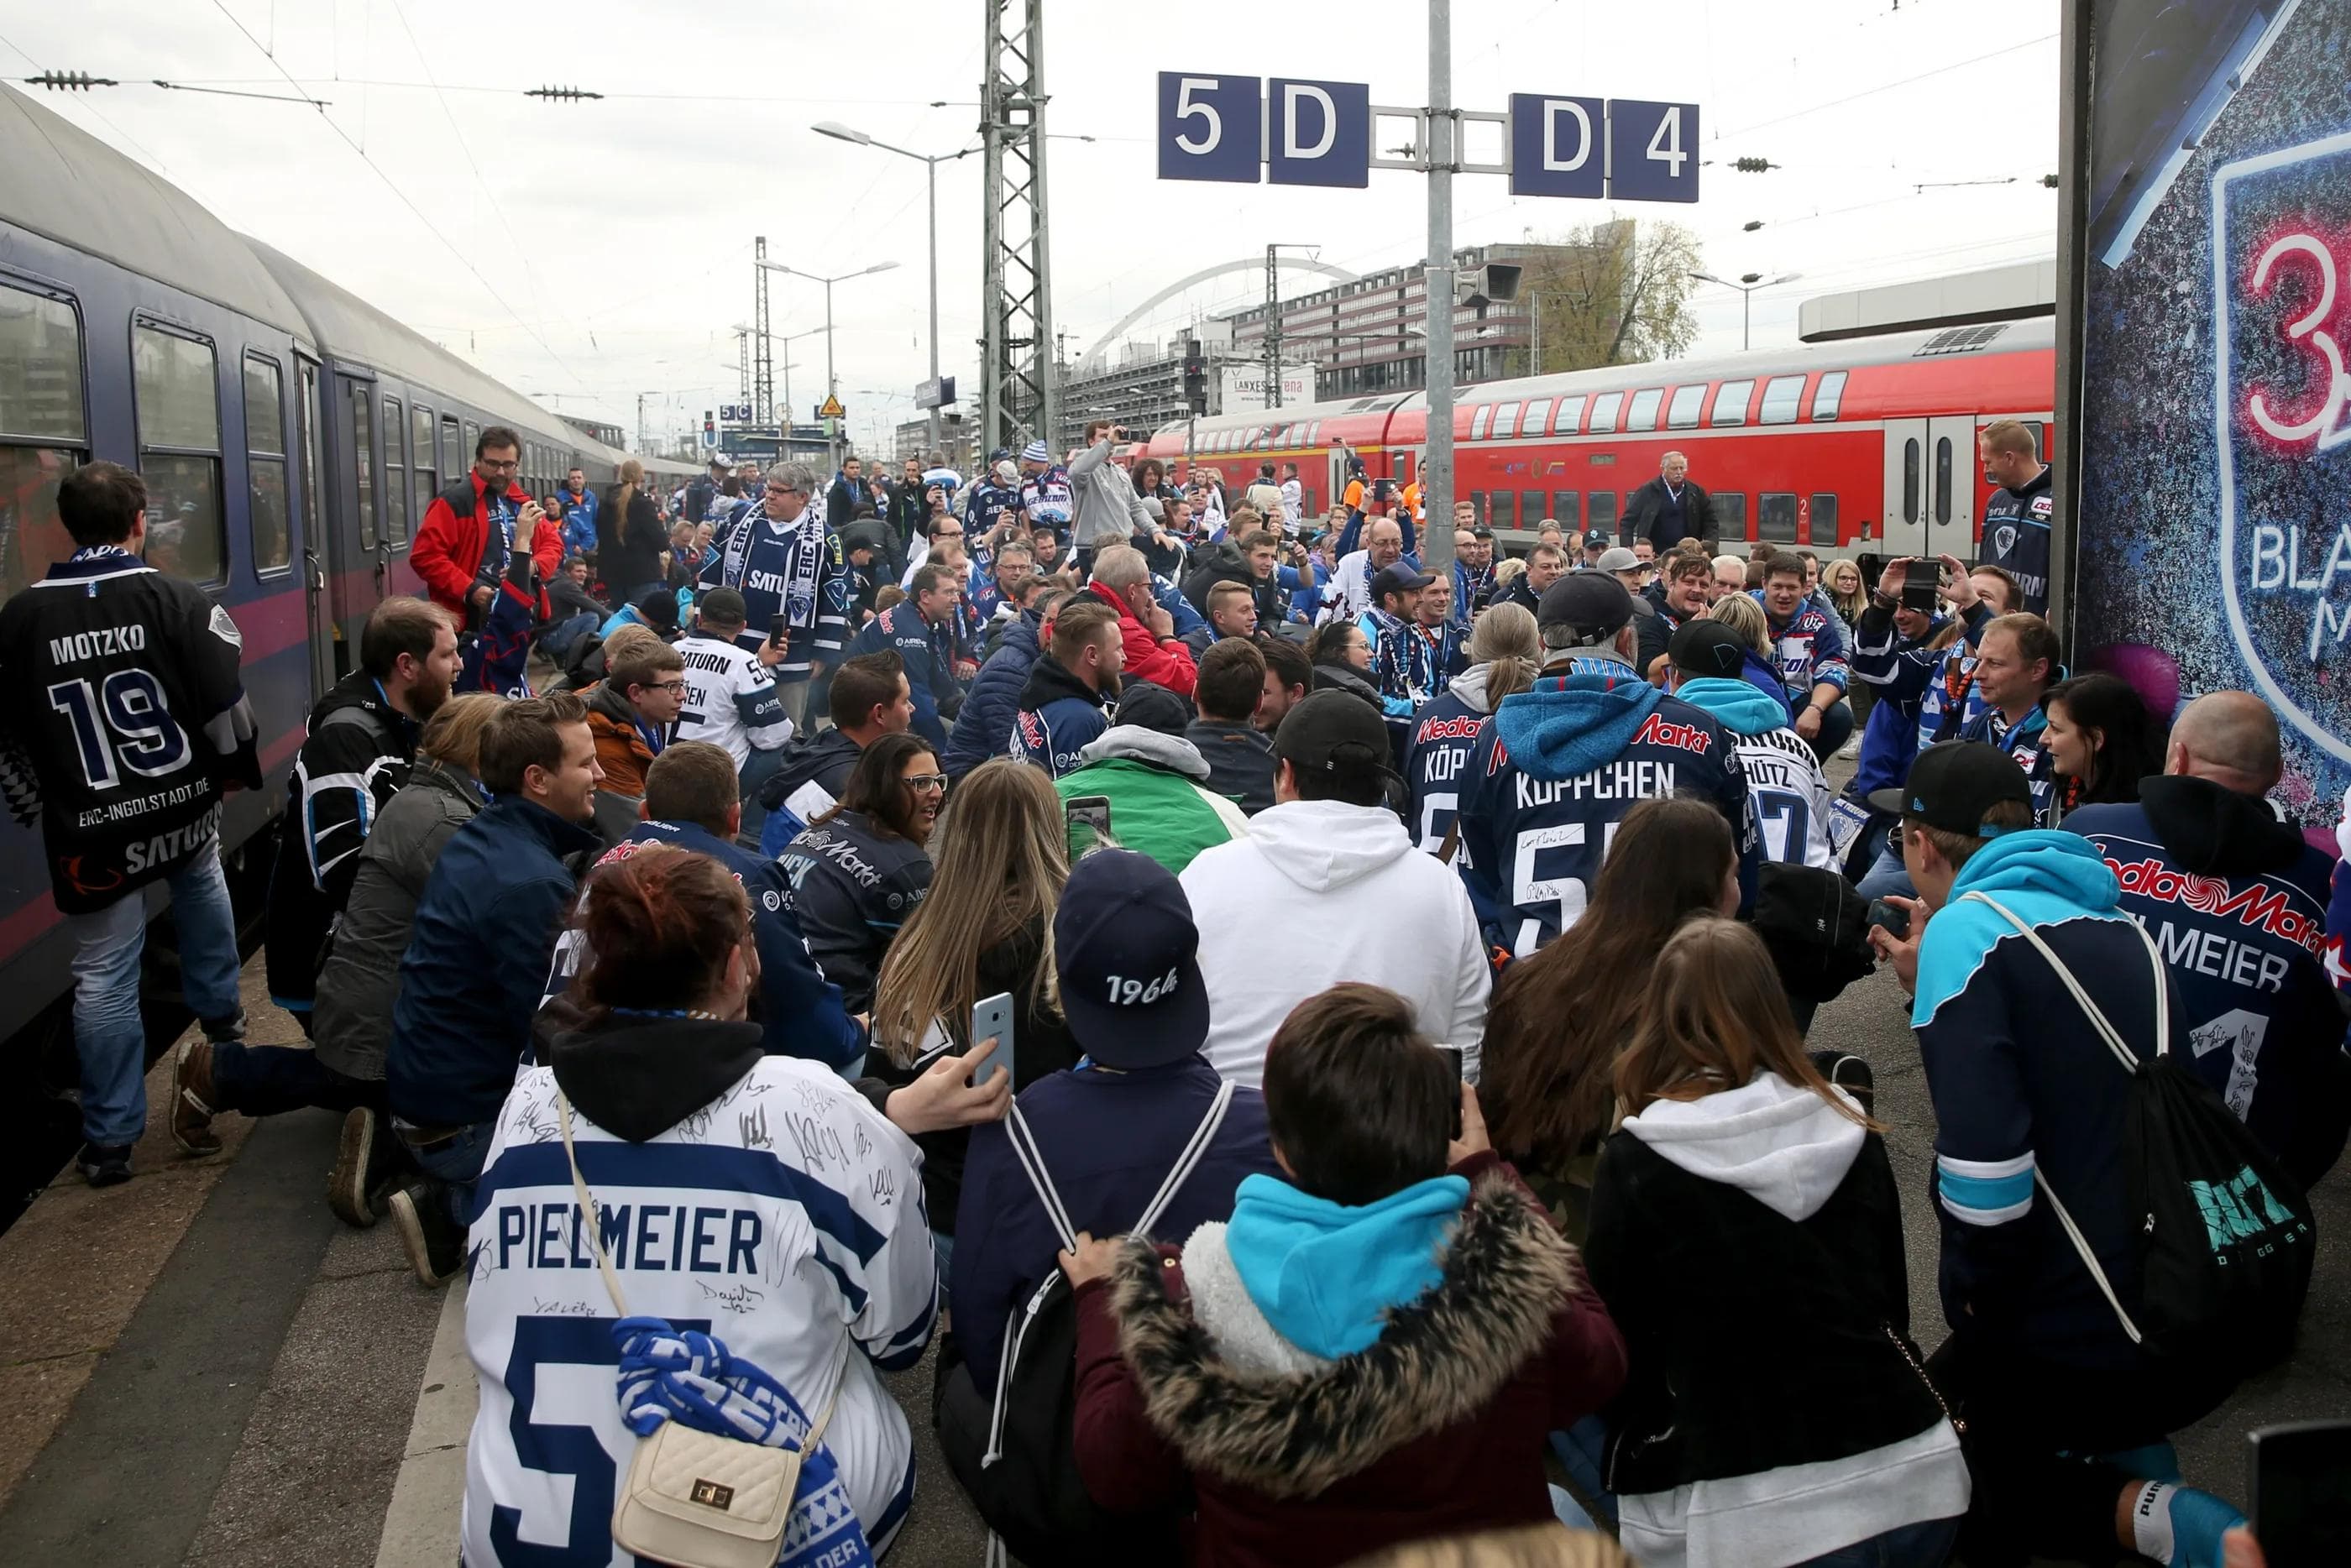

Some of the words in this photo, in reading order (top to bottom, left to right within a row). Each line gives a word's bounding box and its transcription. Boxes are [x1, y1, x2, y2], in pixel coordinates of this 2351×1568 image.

[1176, 77, 1223, 155] 5
[1284, 83, 1338, 159] D
[1543, 99, 1592, 171] D
[1646, 107, 1688, 177] 4
[1234, 379, 1273, 393] LANXES
[720, 405, 730, 418] 5
[738, 405, 748, 418] C
[1799, 499, 1808, 515] 2
[748, 569, 784, 595] SATU
[50, 624, 146, 666] MOTZKO
[47, 667, 193, 791] 19
[1424, 744, 1471, 784] KÖP
[79, 777, 211, 828] ERC-INGOLSTADT.DE
[1106, 967, 1178, 1006] 1964
[499, 1202, 762, 1275] PIELMEIER
[2139, 1480, 2165, 1517] pum
